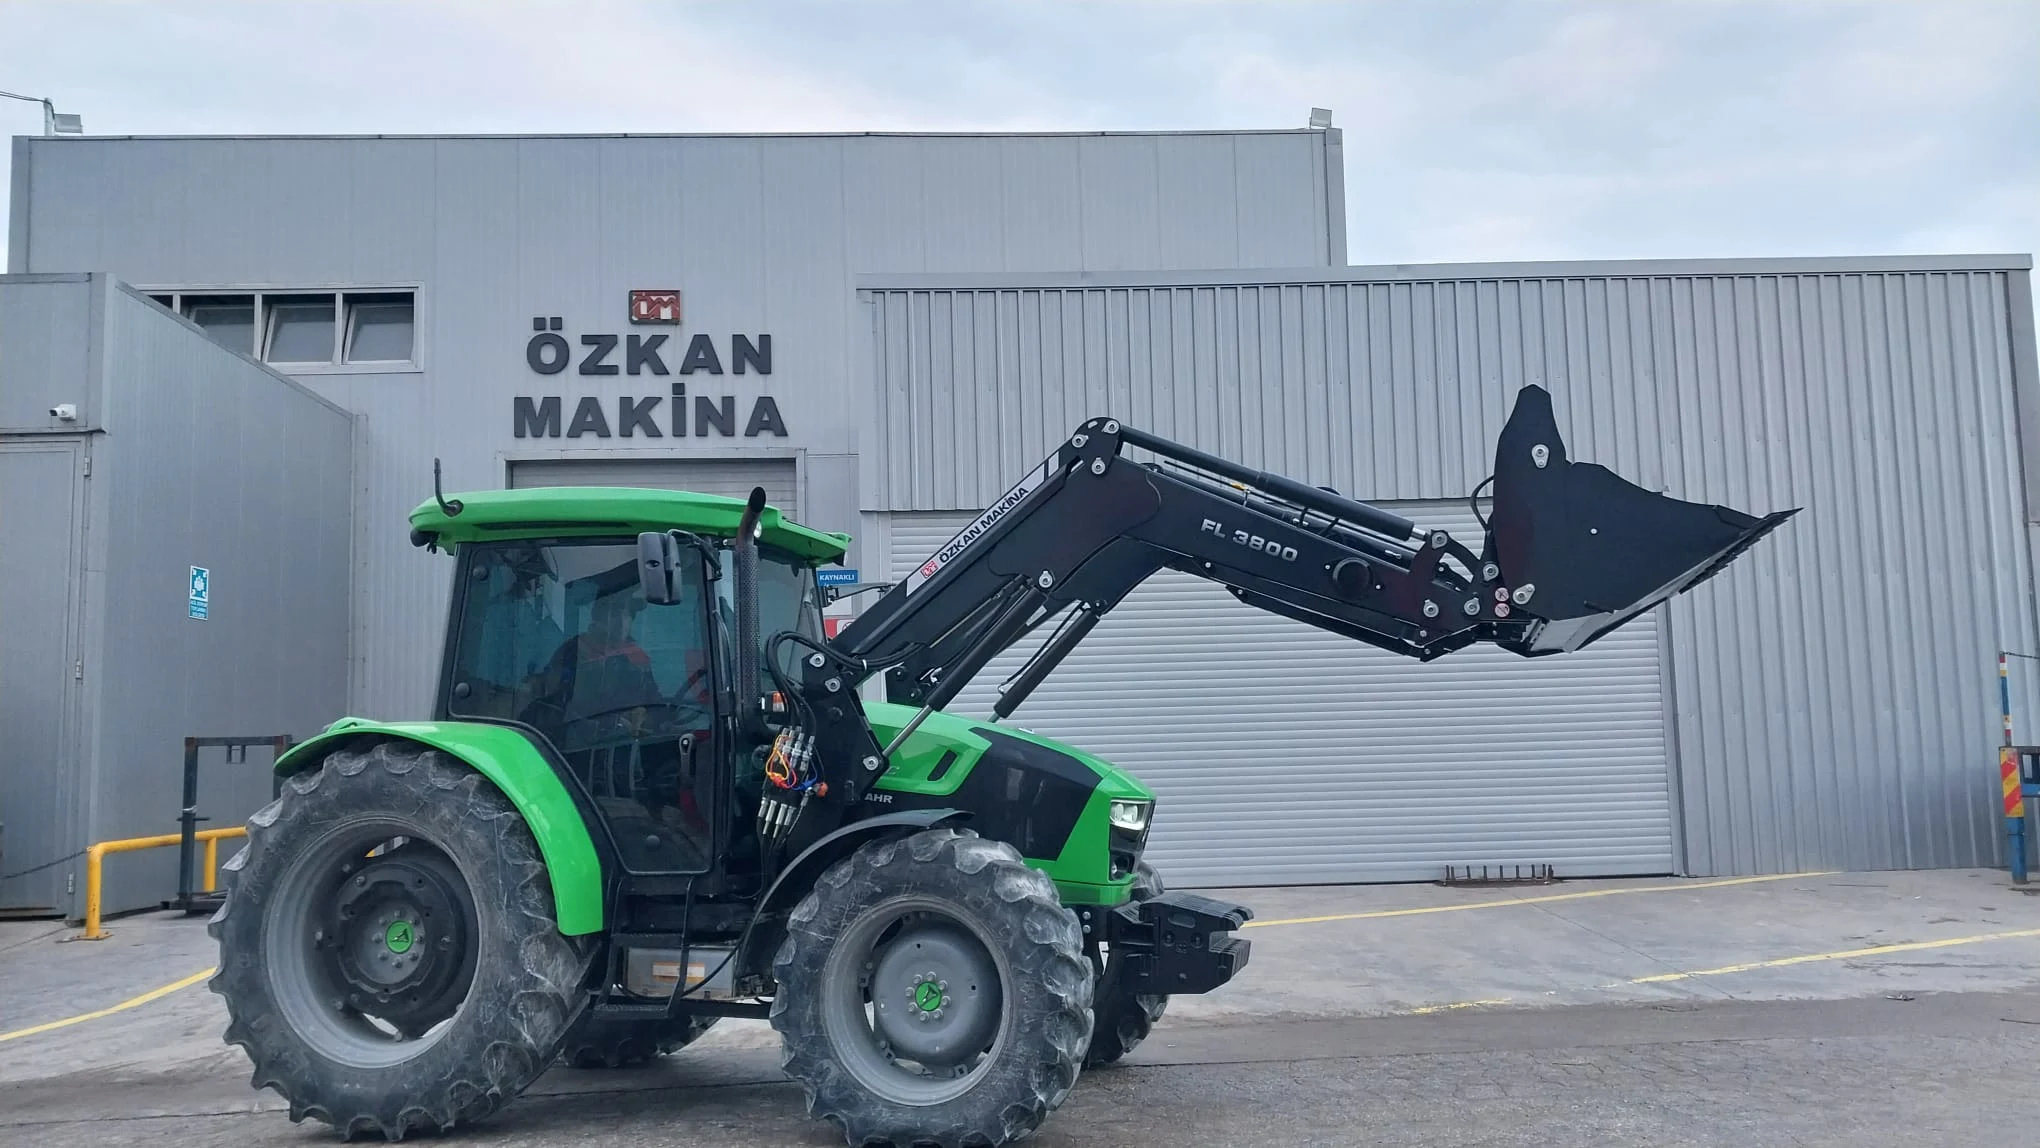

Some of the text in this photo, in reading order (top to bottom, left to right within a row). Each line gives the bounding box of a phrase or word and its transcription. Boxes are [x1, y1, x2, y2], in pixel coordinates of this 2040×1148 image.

[526, 317, 772, 375] ÖZKAN
[513, 382, 789, 438] MAKİNA
[939, 487, 1029, 563] ÖZKAN MAKİNA
[1200, 518, 1298, 562] FL 3800
[864, 793, 893, 804] AHR
